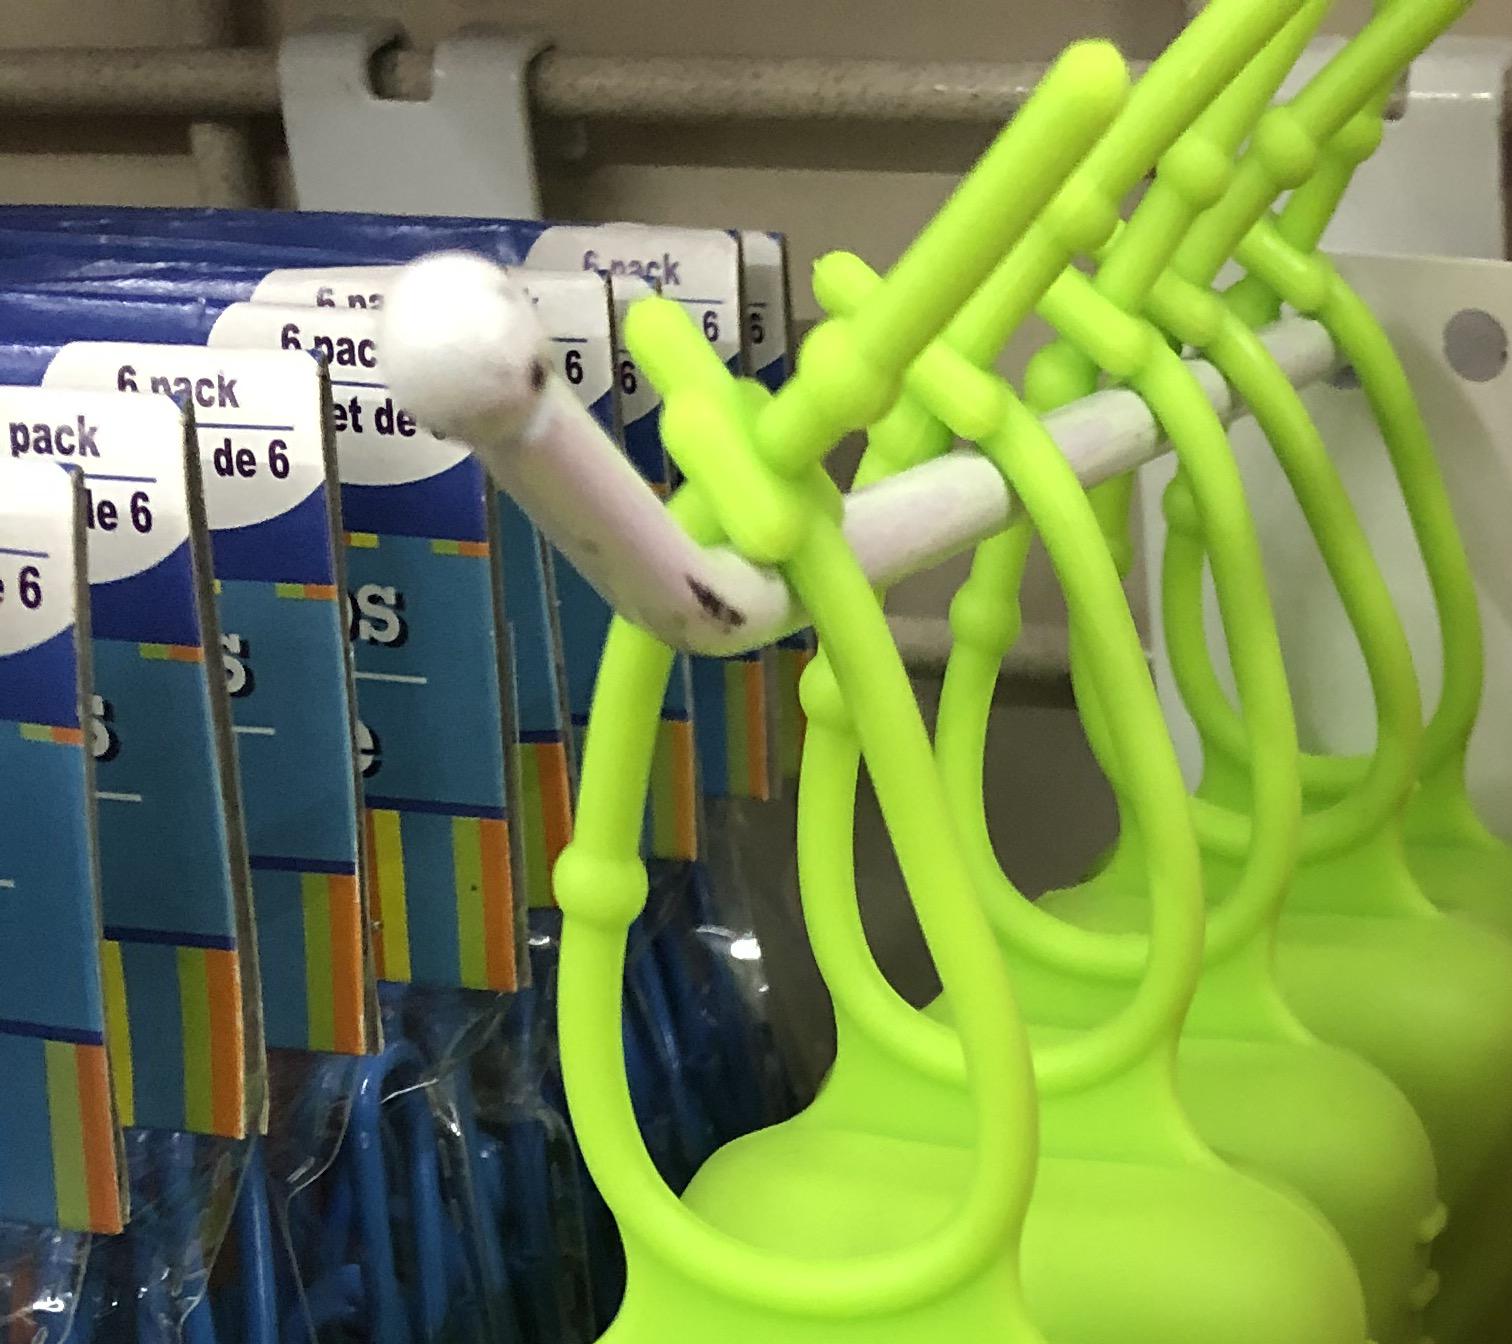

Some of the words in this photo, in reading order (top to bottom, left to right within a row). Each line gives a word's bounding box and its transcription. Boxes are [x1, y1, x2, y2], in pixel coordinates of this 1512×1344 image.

[702, 310, 720, 343] 6
[313, 333, 378, 368] pac
[564, 350, 584, 385] 6
[620, 360, 638, 395] 6
[9, 415, 101, 458] pack
[213, 438, 257, 478] de
[268, 439, 290, 479] 6
[130, 491, 153, 533] 6
[18, 565, 42, 609] 6
